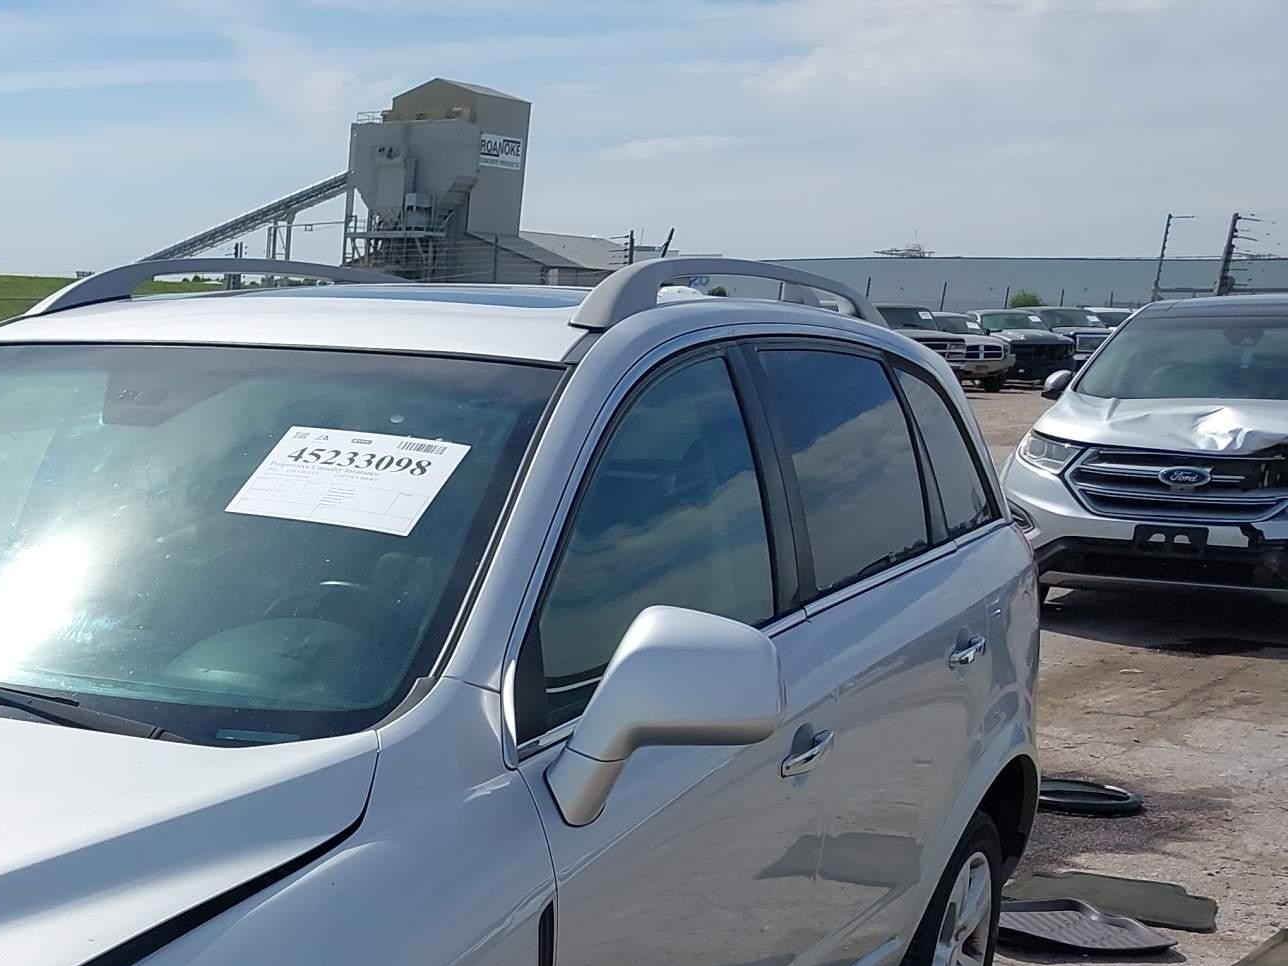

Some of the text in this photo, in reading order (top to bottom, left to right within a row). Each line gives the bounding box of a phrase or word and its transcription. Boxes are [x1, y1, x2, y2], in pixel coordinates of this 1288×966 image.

[480, 139, 520, 157] ROANOKE
[287, 446, 432, 477] 45233098
[1169, 471, 1199, 481] Ford
